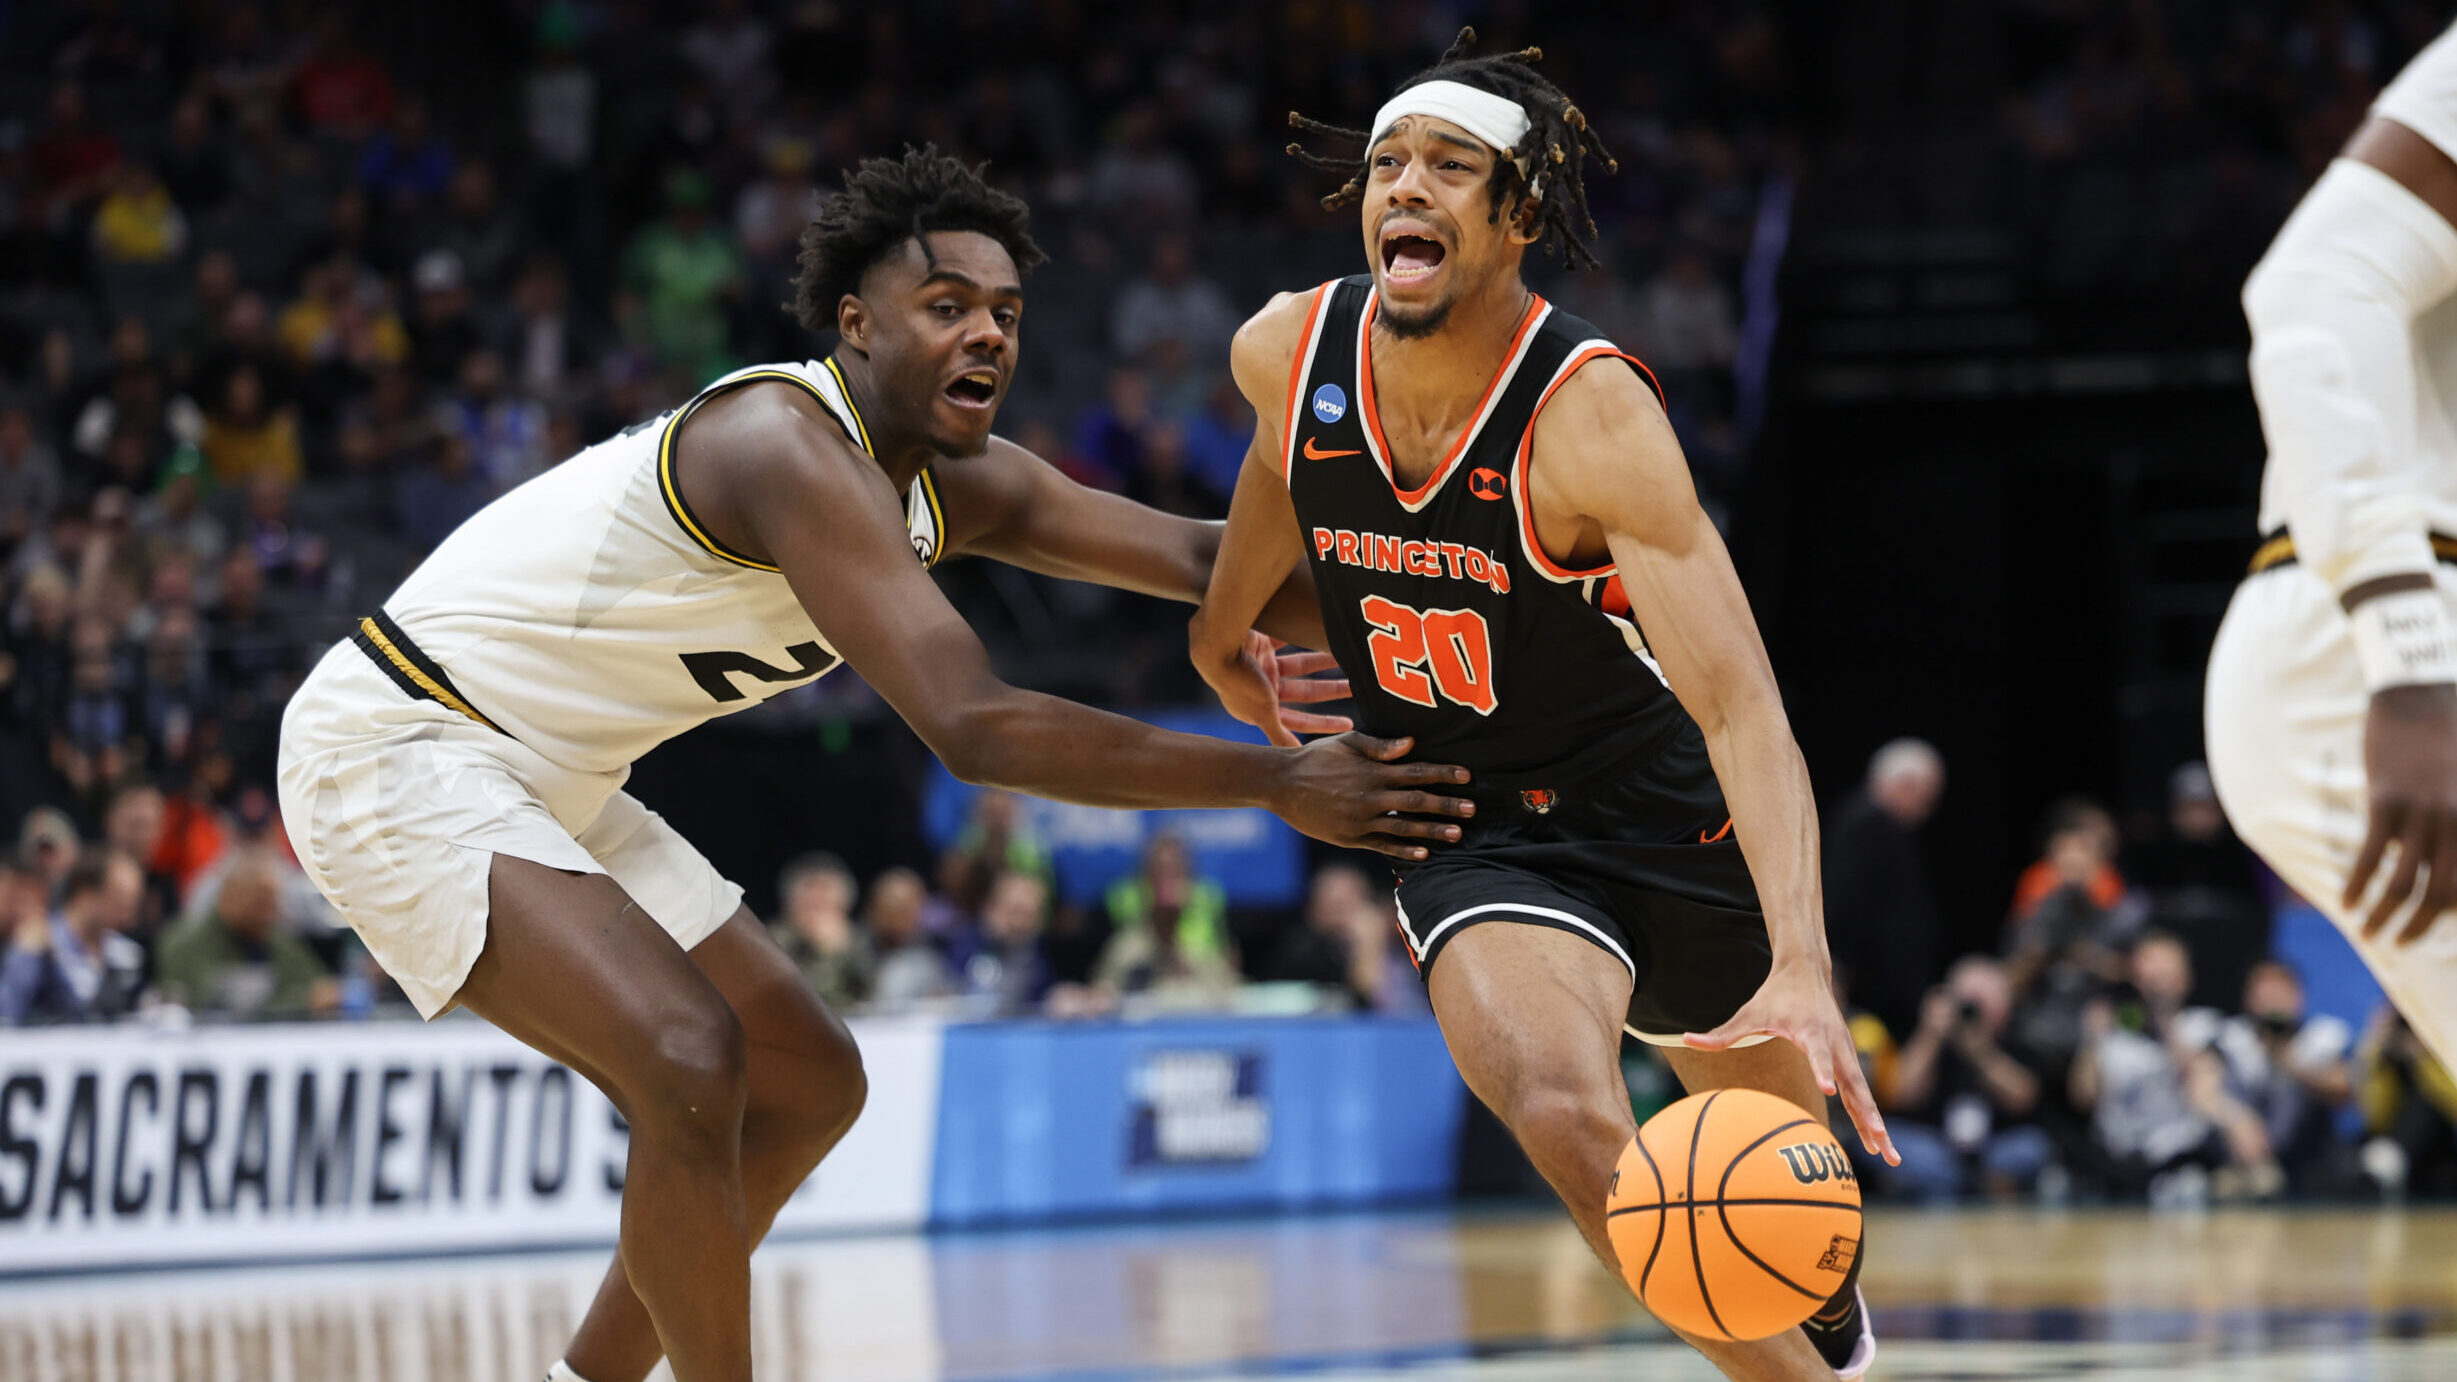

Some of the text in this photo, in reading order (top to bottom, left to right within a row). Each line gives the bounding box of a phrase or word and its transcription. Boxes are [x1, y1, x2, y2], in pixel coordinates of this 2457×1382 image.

[1315, 399, 1343, 417] NCAA
[1313, 527, 1511, 594] PRINCETON
[1360, 594, 1498, 716] 20
[0, 1066, 571, 1221] SACRAMENTO
